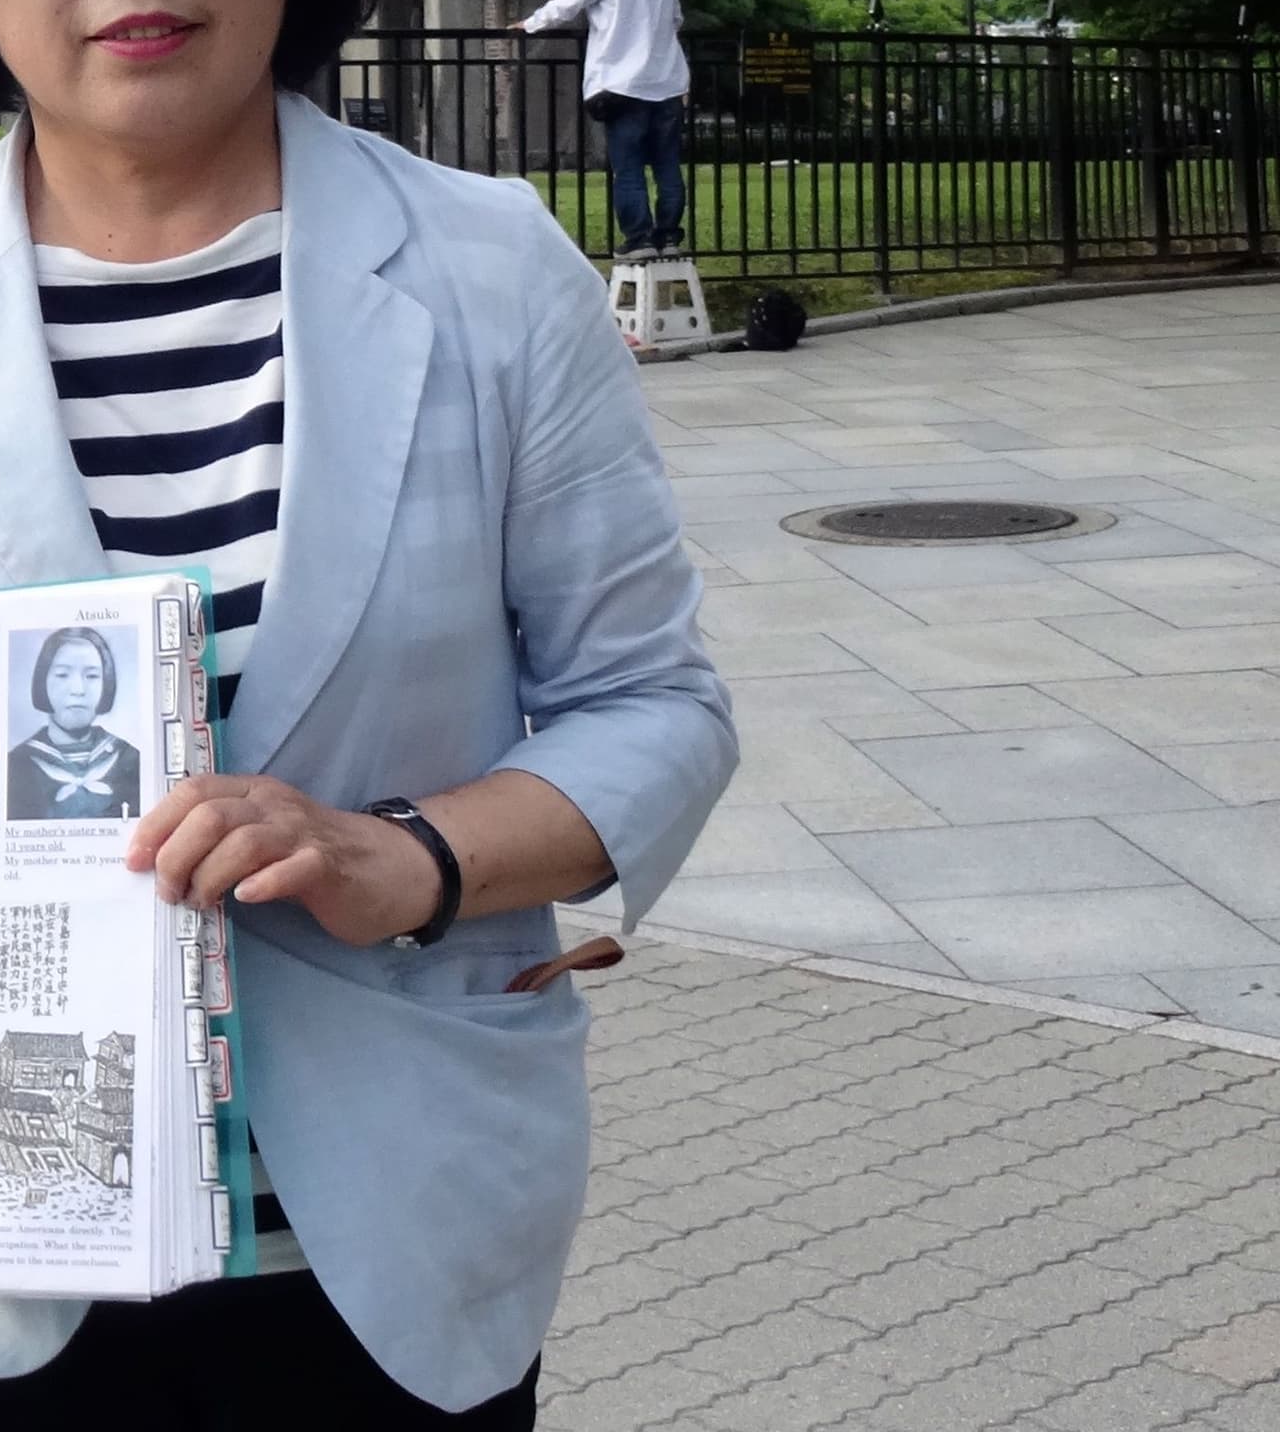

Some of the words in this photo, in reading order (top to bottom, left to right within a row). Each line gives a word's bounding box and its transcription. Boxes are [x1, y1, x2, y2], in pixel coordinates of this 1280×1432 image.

[75, 608, 120, 621] Atsuko
[4, 826, 19, 838] My
[23, 826, 65, 836] mother's
[68, 827, 95, 836] sister
[99, 828, 119, 836] was
[19, 843, 44, 853] years
[4, 856, 19, 867] My
[23, 856, 58, 865] mother
[84, 856, 96, 865] 20
[4, 871, 22, 880] old.
[44, 1240, 68, 1250] What
[72, 1240, 86, 1250] the
[90, 1243, 132, 1251] survivors
[28, 1256, 42, 1264] the
